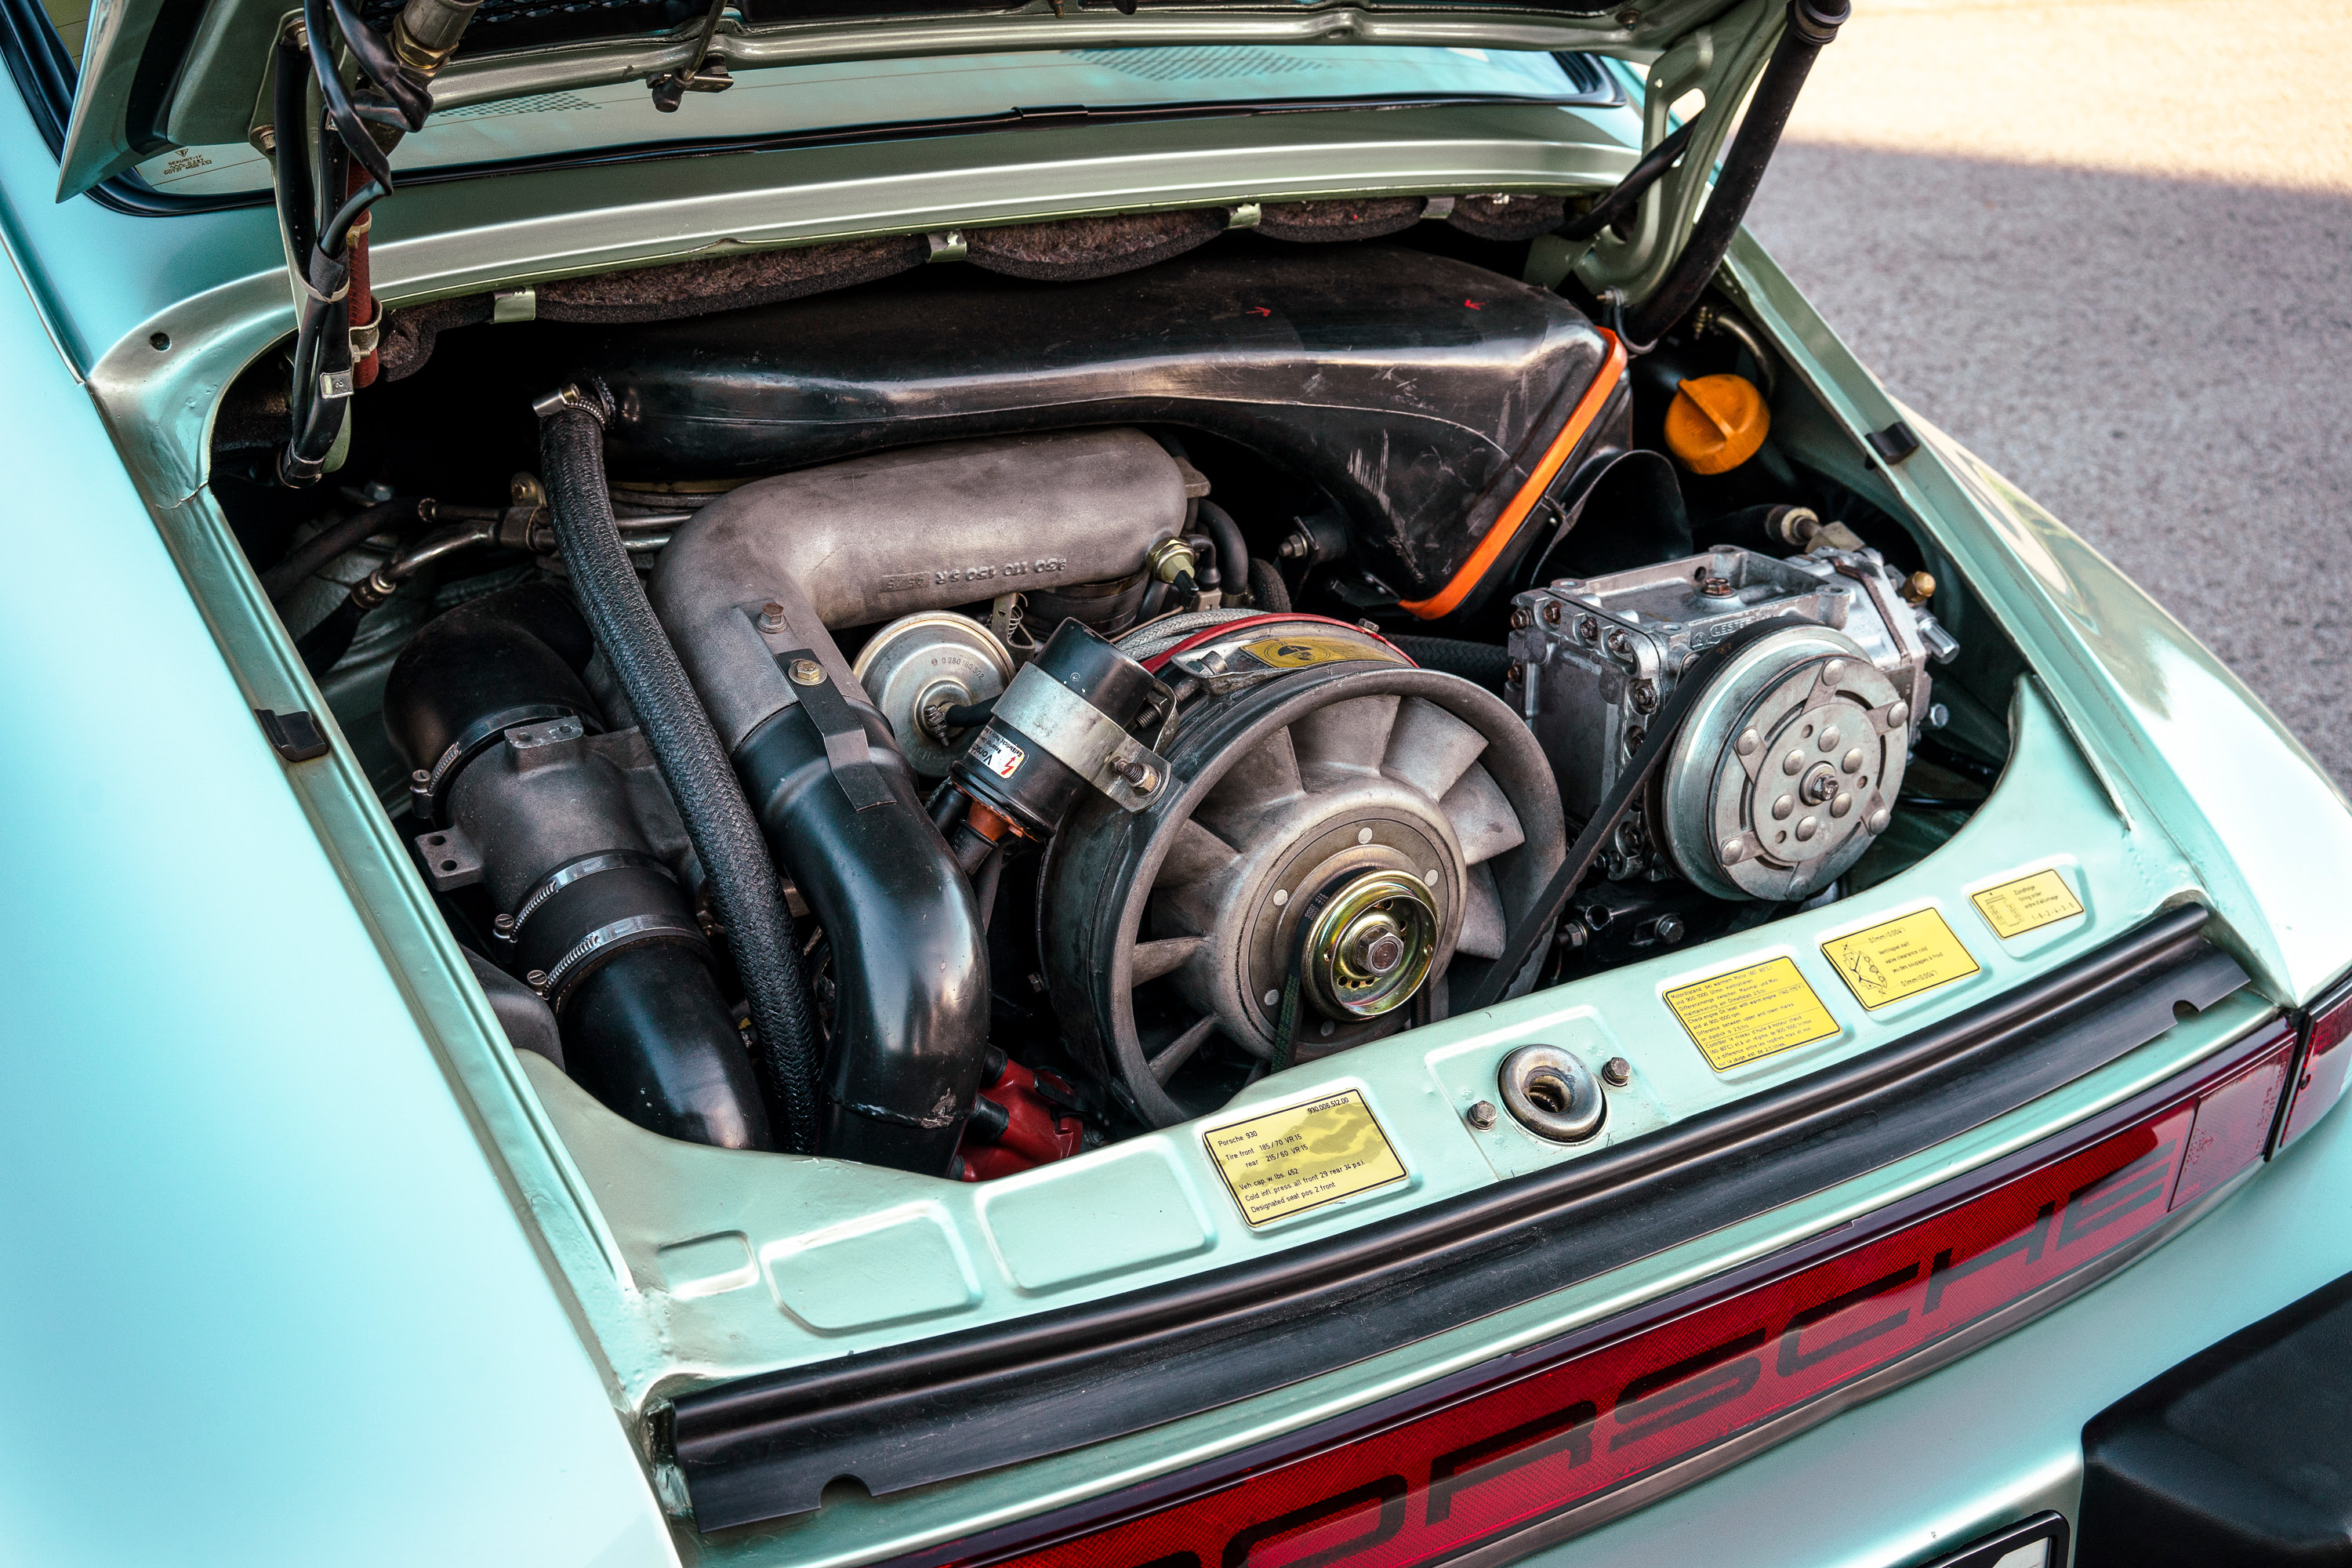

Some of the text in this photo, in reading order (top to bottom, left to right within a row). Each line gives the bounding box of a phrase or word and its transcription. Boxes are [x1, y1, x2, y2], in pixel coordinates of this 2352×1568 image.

[962, 661, 973, 670] 160
[973, 667, 984, 680] 302
[1307, 1097, 1349, 1114] 930.006.512.00
[1218, 1130, 1258, 1147] Porsche 930
[1239, 1148, 1255, 1157] front
[1245, 1192, 1260, 1201] Cold
[1302, 1174, 1319, 1183] front
[1250, 1197, 1285, 1213] Designated
[1286, 1193, 1300, 1202] seat
[1320, 1182, 1336, 1191] front
[1134, 1138, 2176, 1568] ORSCHE
